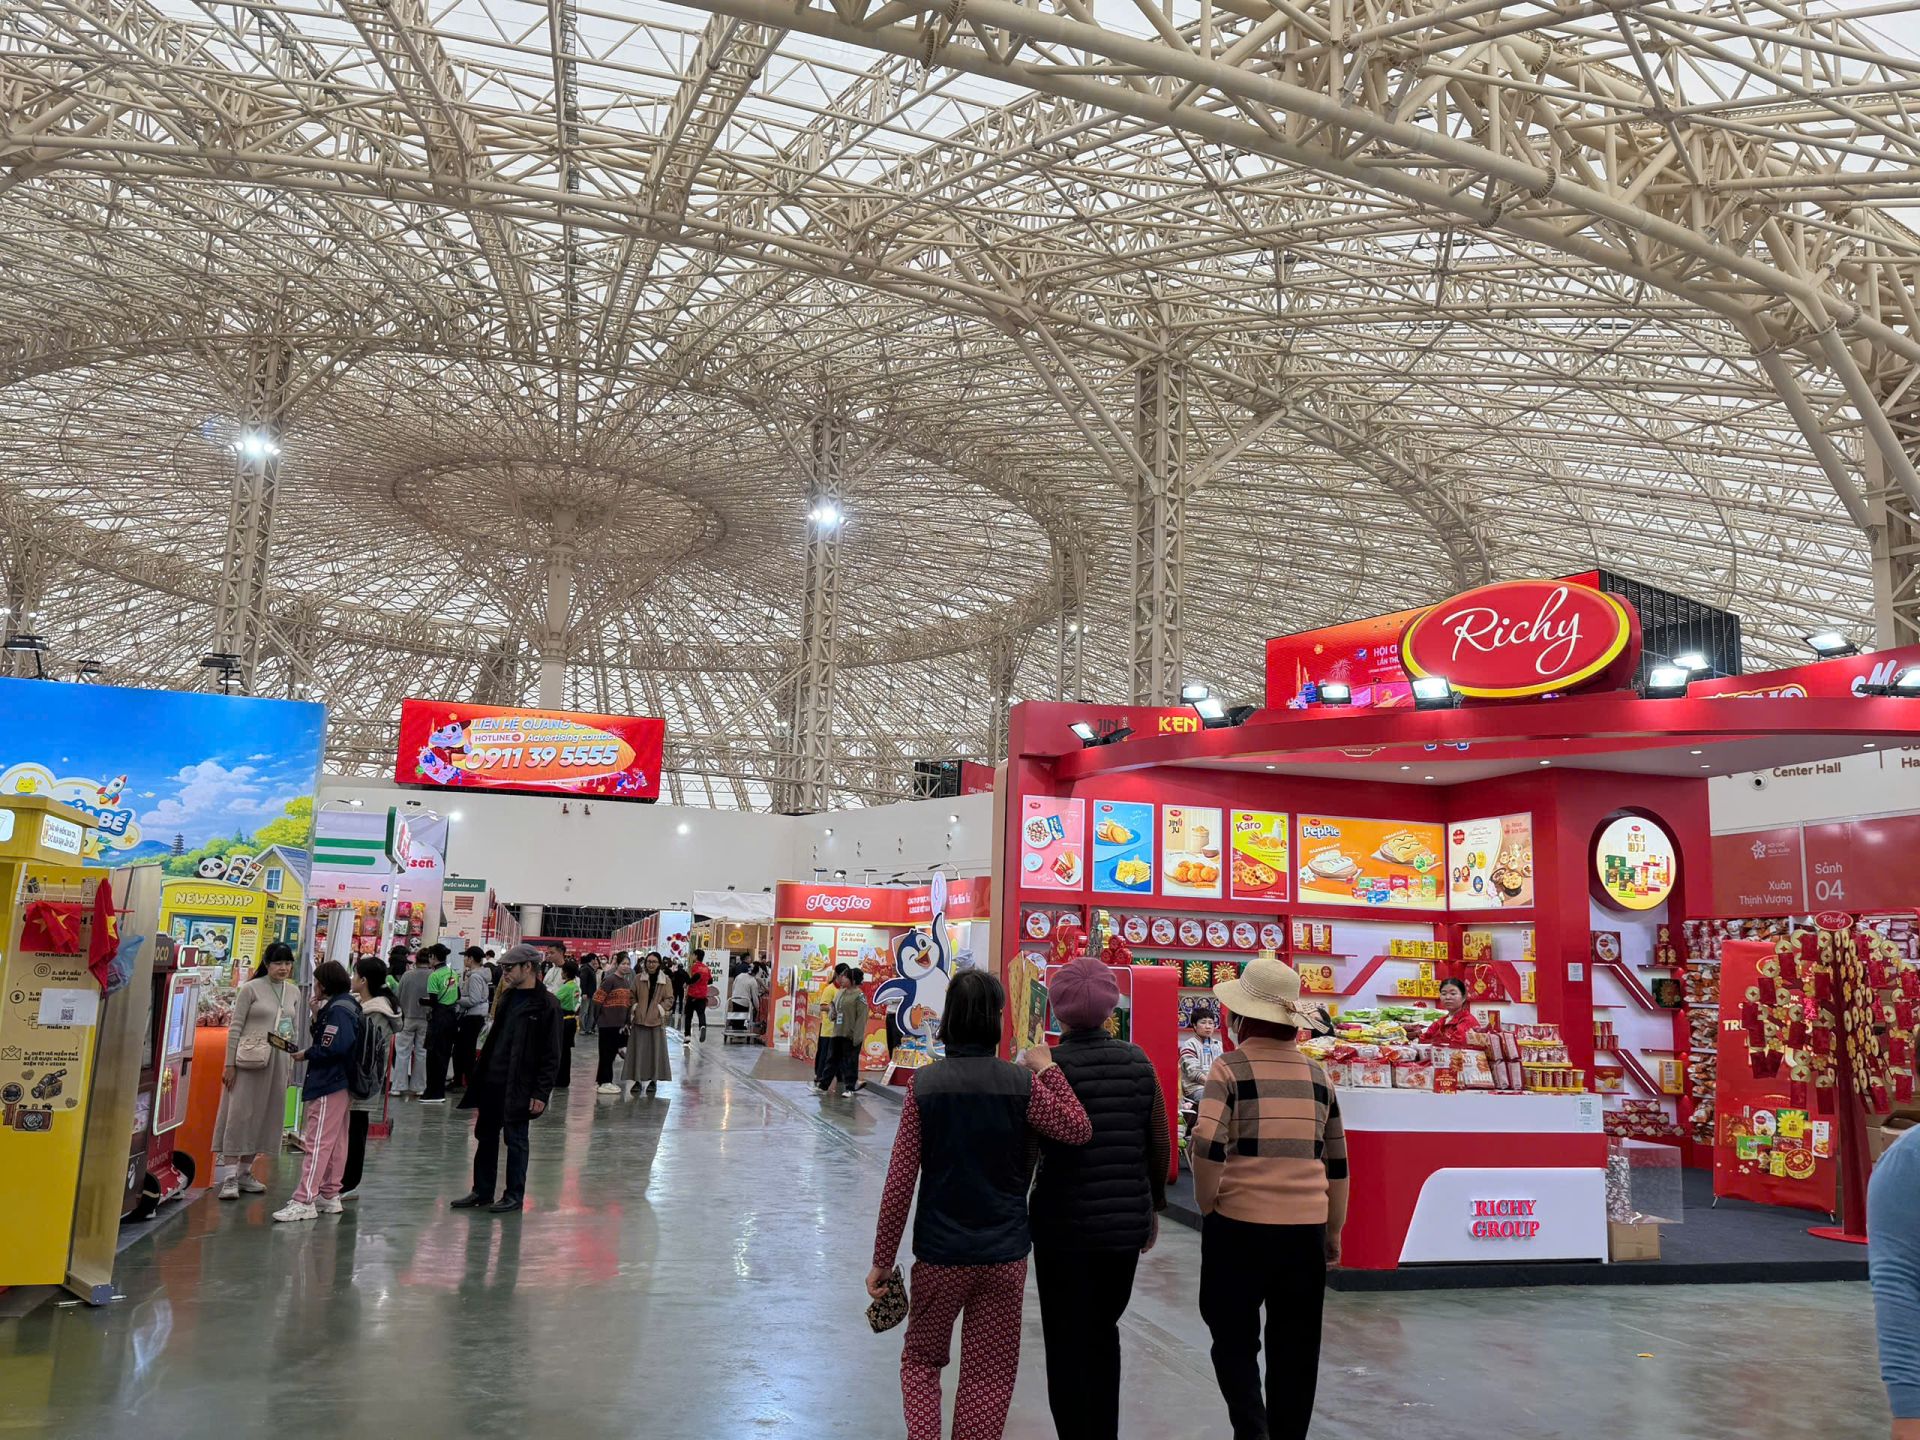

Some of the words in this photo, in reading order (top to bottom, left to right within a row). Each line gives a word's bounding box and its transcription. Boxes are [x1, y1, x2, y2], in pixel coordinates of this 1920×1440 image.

[1442, 586, 1583, 675] Richy
[1158, 716, 1198, 733] KEN
[475, 734, 511, 742] HOTLINE
[526, 733, 579, 743] Advertising
[465, 747, 523, 769] 0911
[525, 746, 557, 768] 39
[559, 745, 619, 767] 5555
[1773, 766, 1812, 778] Center
[1816, 762, 1842, 775] Hall
[99, 811, 125, 832] BÉ
[1236, 821, 1261, 832] Karo
[1815, 862, 1843, 875] Sảnh
[1768, 880, 1792, 891] Xuân
[1815, 879, 1845, 901] 04
[175, 892, 253, 906] NEWSSNAP
[1739, 895, 1762, 908] Thịnh
[1474, 1199, 1536, 1216] RICHY
[1472, 1220, 1540, 1238] GROUP
